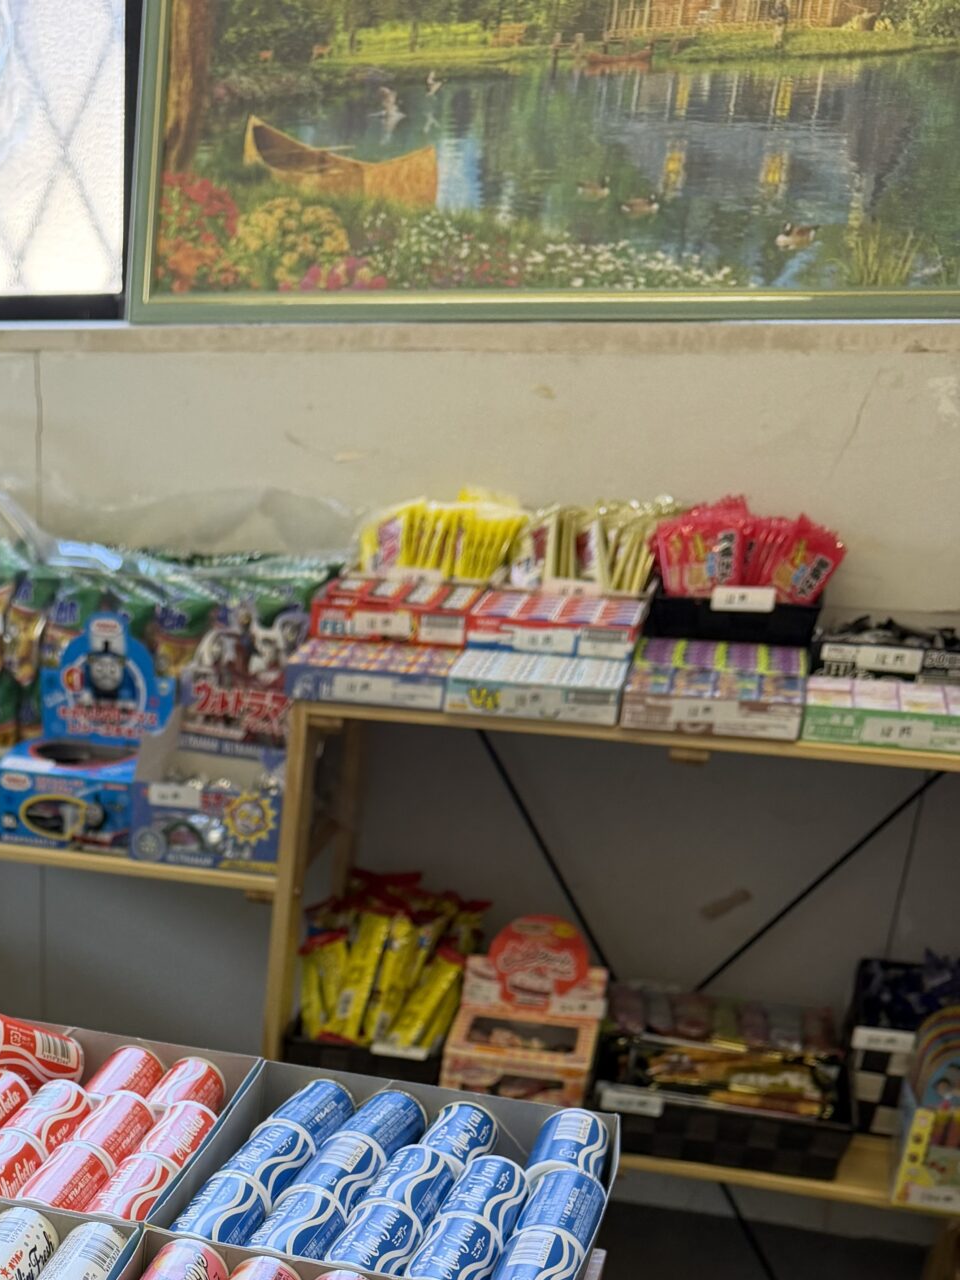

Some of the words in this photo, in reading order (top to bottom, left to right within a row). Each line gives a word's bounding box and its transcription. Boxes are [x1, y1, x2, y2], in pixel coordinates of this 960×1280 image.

[193, 682, 289, 727] ウルトラマ
